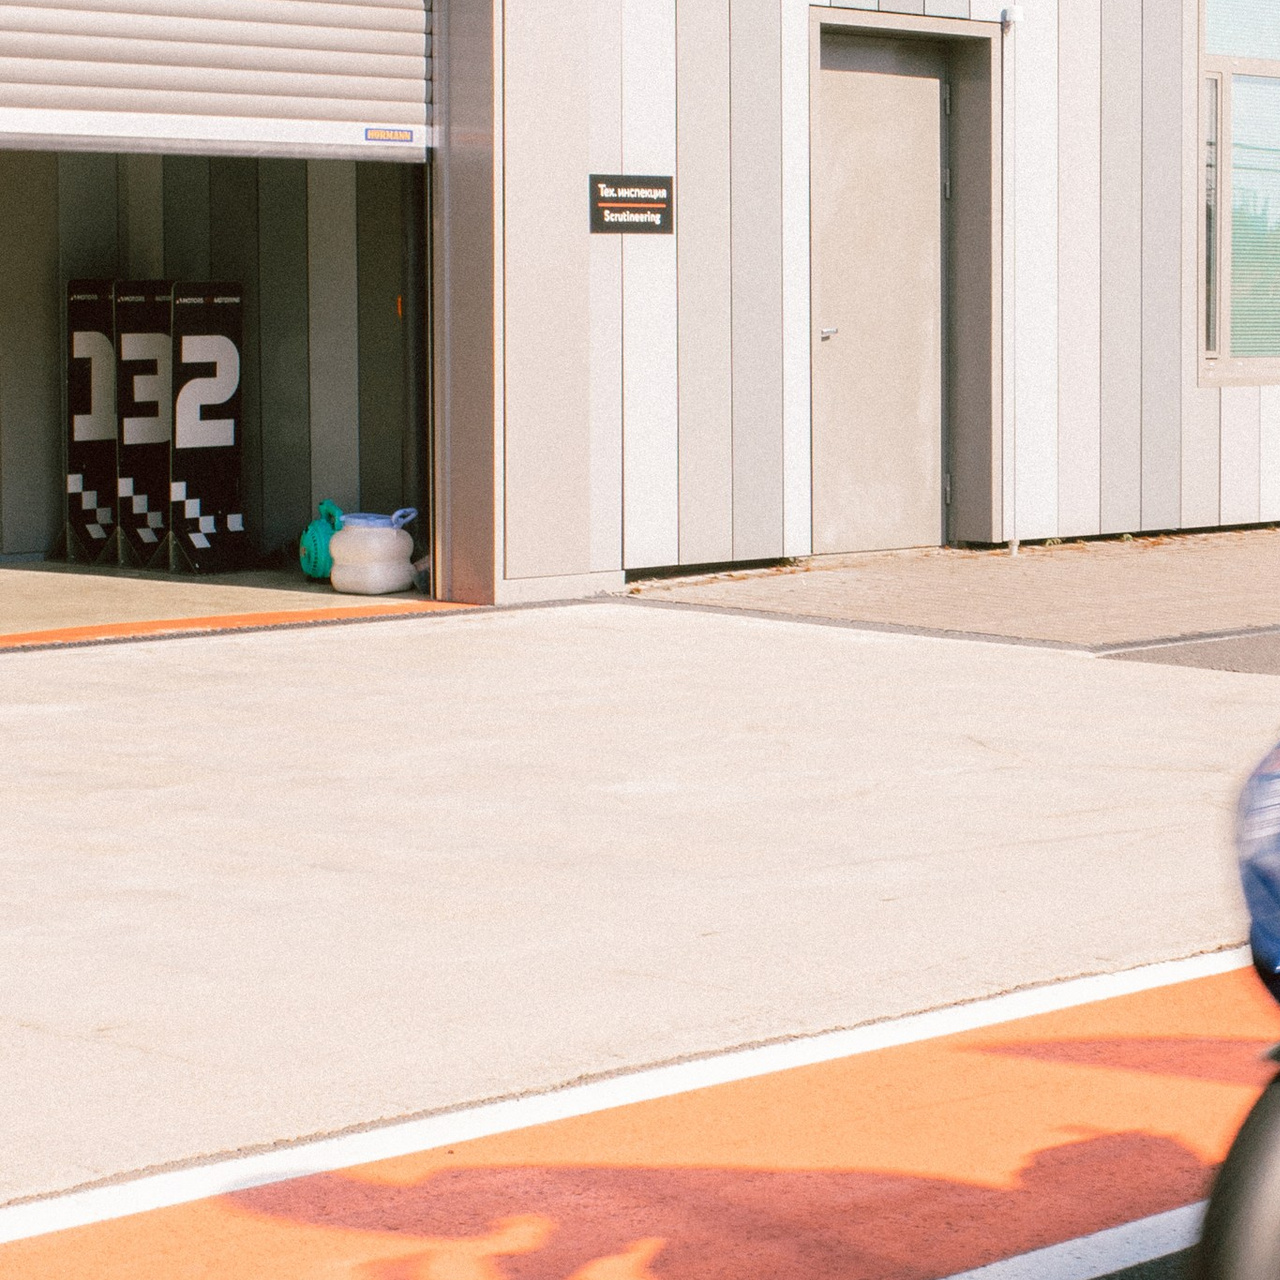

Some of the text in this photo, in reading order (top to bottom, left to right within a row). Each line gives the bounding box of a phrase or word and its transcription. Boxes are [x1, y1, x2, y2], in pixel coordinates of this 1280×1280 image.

[597, 183, 667, 200] Тех. инспекция
[603, 209, 661, 225] Scrutineering
